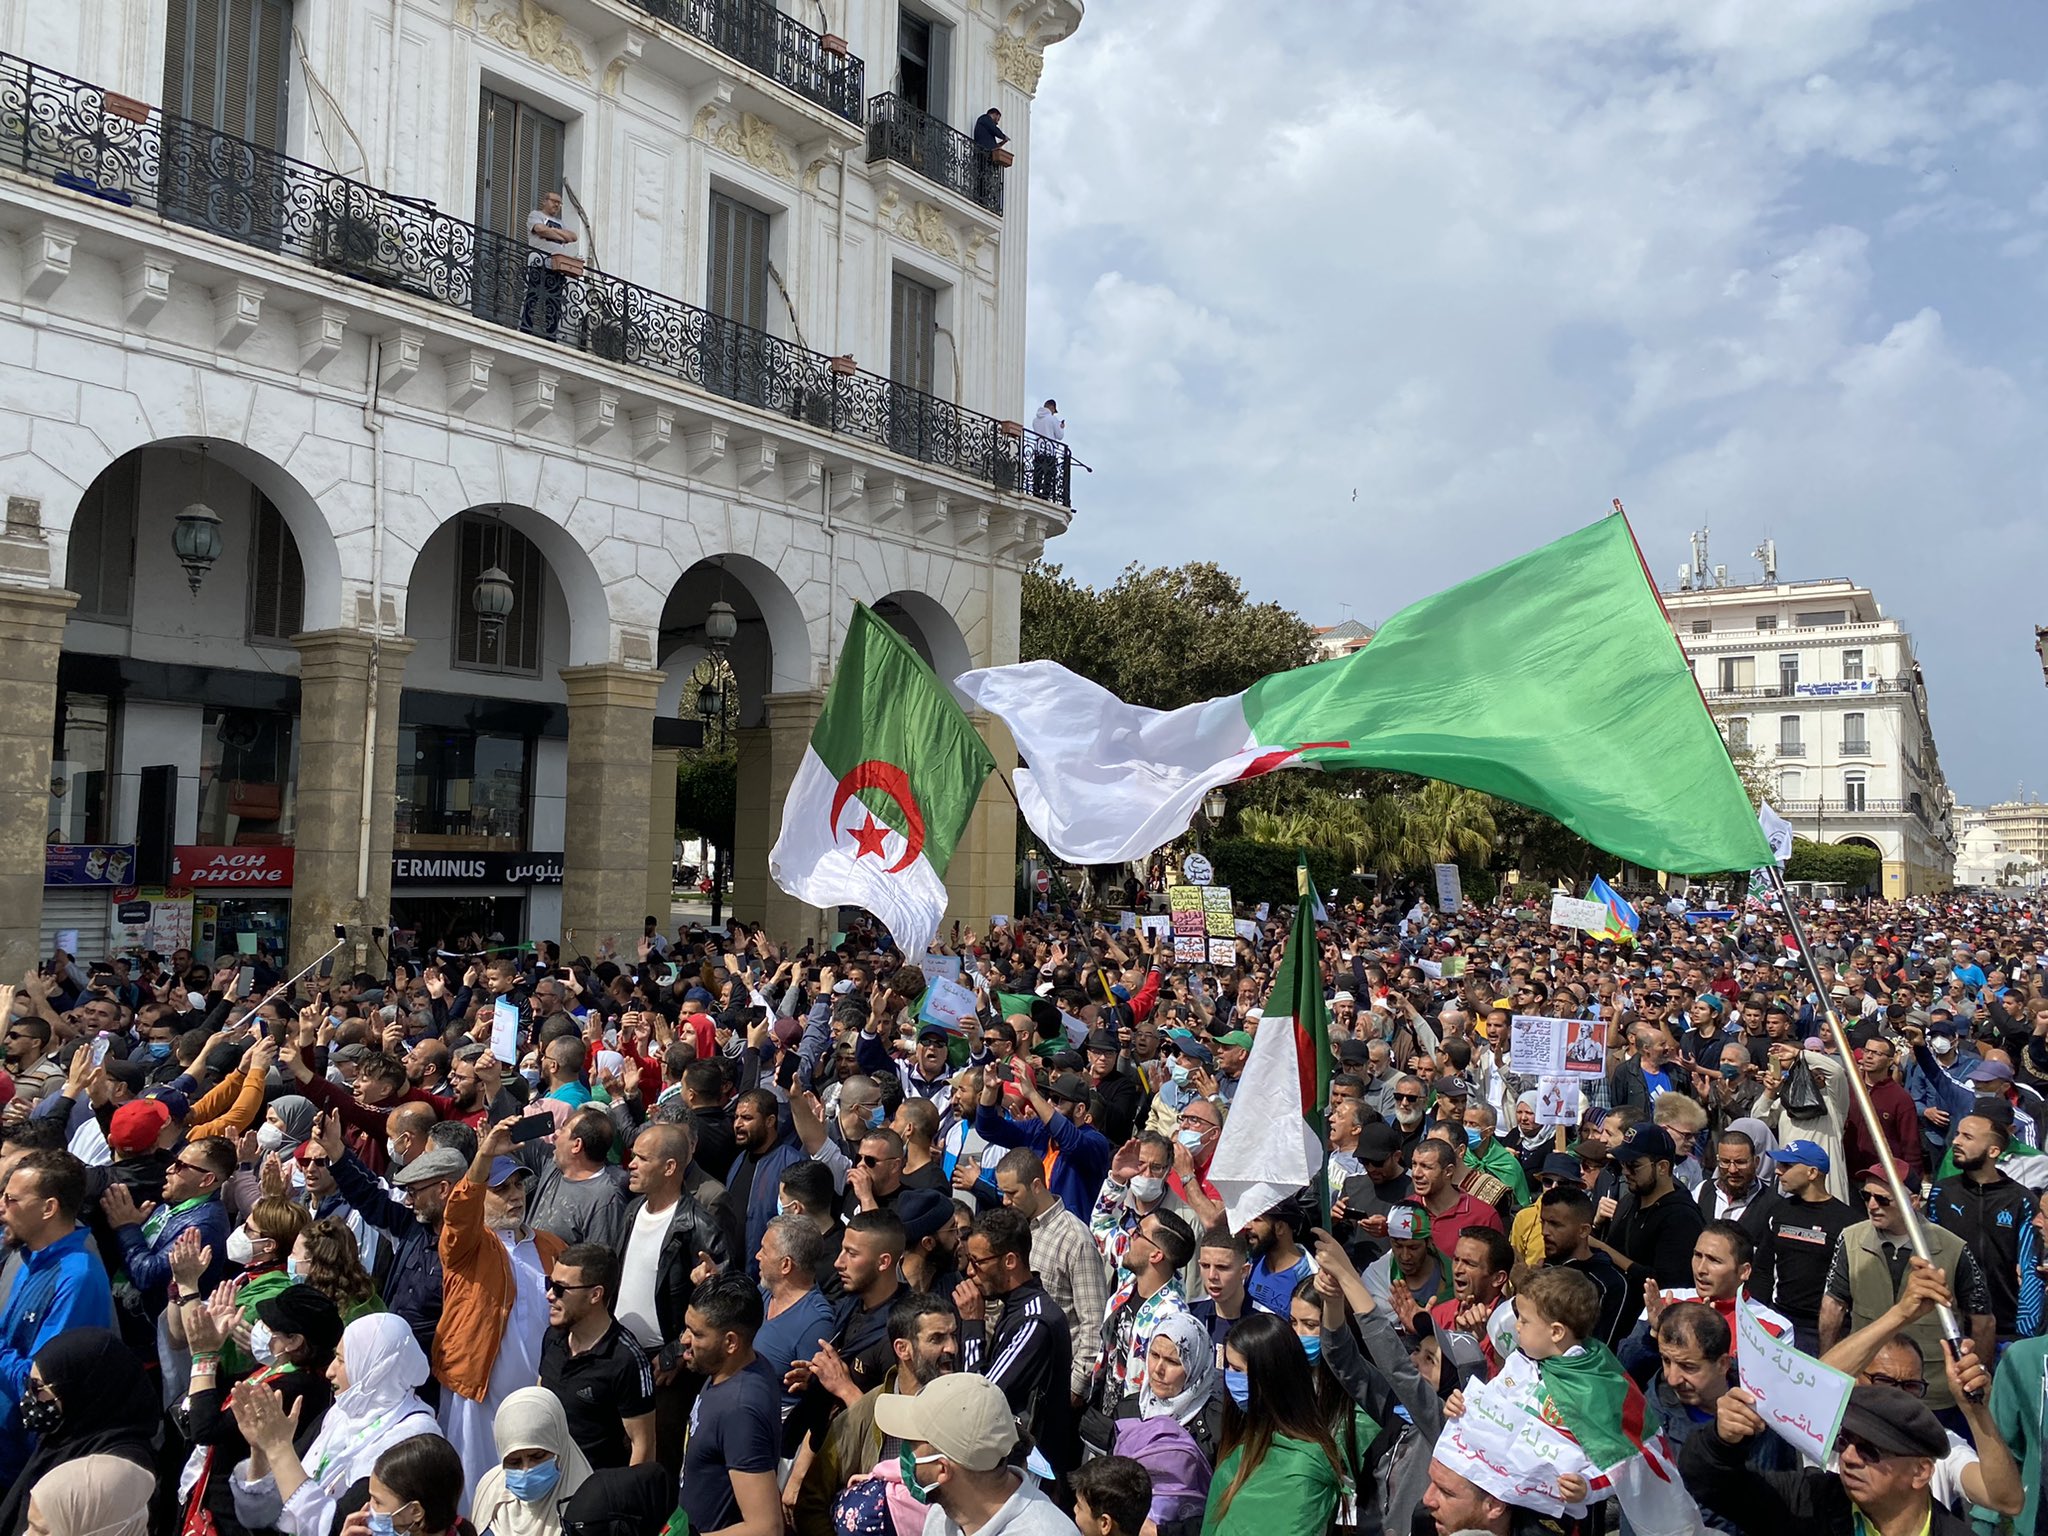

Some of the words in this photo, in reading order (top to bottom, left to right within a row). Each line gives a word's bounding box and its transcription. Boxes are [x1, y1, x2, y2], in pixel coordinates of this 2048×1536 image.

[190, 869, 283, 882] PHONE
[208, 854, 267, 867] ACH
[1738, 1309, 1766, 1357] مدنية
[1771, 1348, 1816, 1388] دولة
[1472, 1390, 1516, 1433] مدنية
[1773, 1408, 1825, 1443] ماشي
[1451, 1427, 1511, 1478] عسكرية
[1520, 1421, 1560, 1461] دولة
